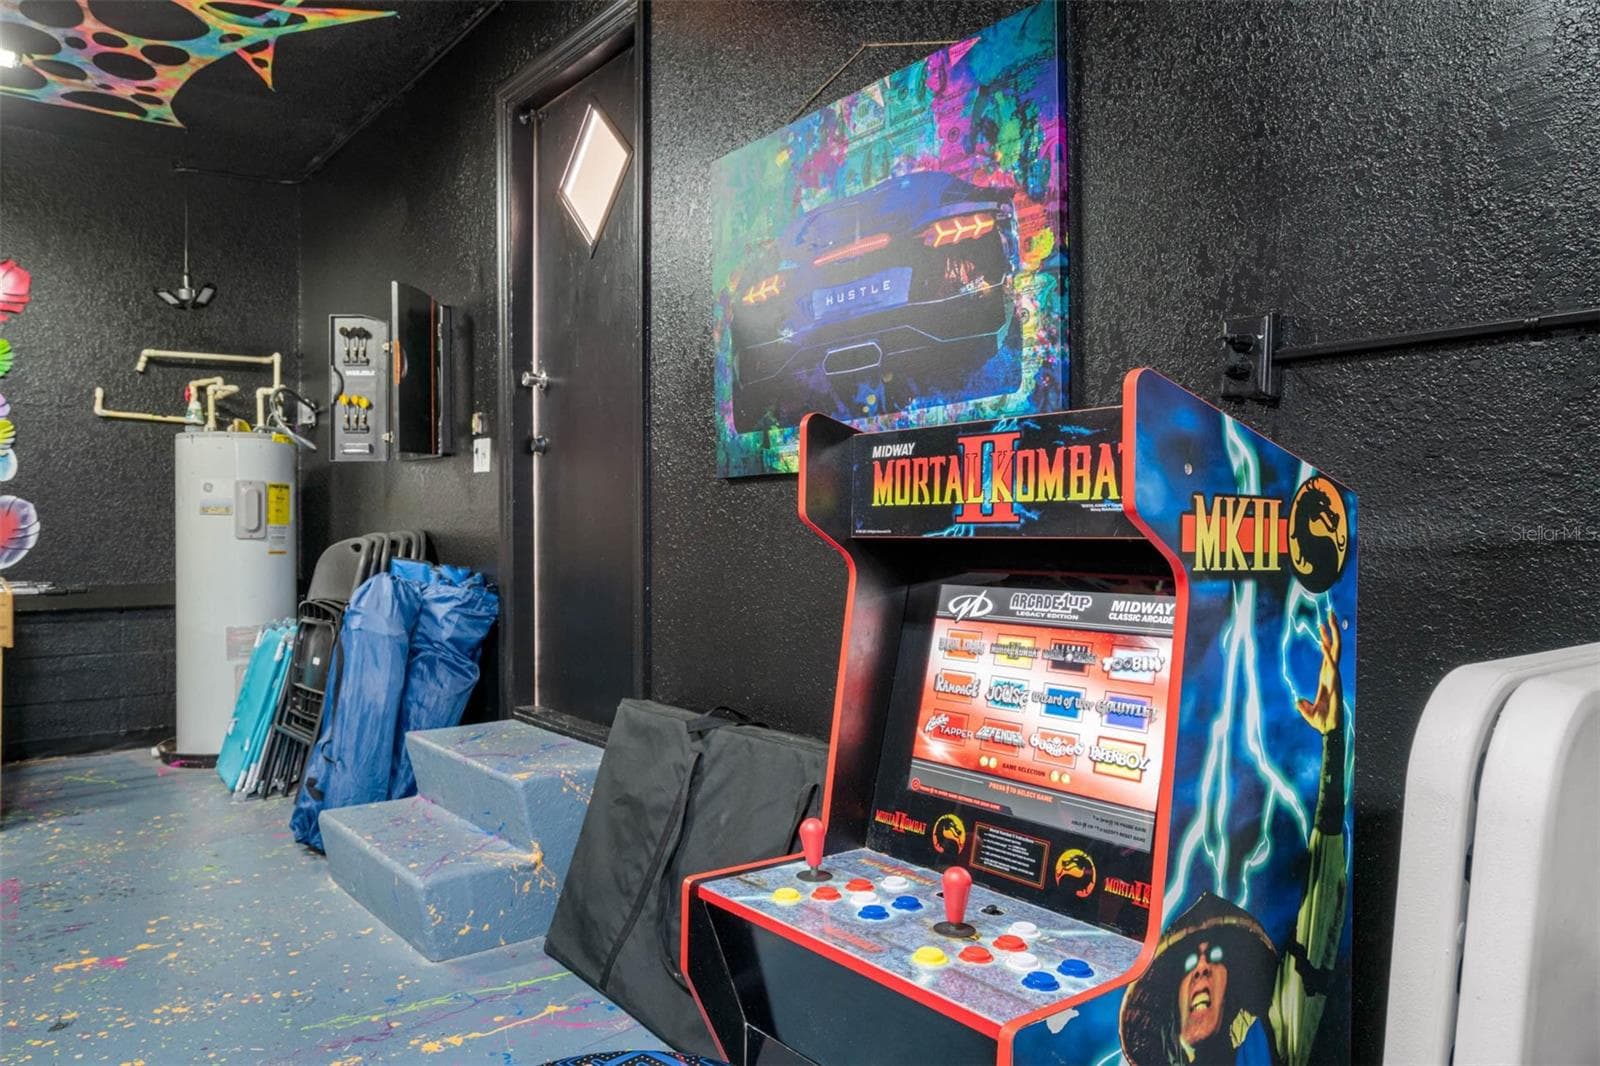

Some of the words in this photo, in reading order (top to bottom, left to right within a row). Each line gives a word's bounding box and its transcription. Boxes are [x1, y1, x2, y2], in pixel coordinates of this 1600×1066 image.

[825, 280, 891, 305] HUSTLE
[872, 442, 915, 458] MIDWAY
[871, 452, 983, 506] MORTAL
[989, 442, 1123, 503] KOMBA
[1193, 495, 1282, 571] MKII
[1111, 601, 1175, 615] MIDWAY
[1108, 613, 1140, 622] CLASSIC
[1141, 616, 1174, 624] ARCADE
[934, 673, 981, 698] RAMPAGE
[940, 726, 974, 739] TAPPER
